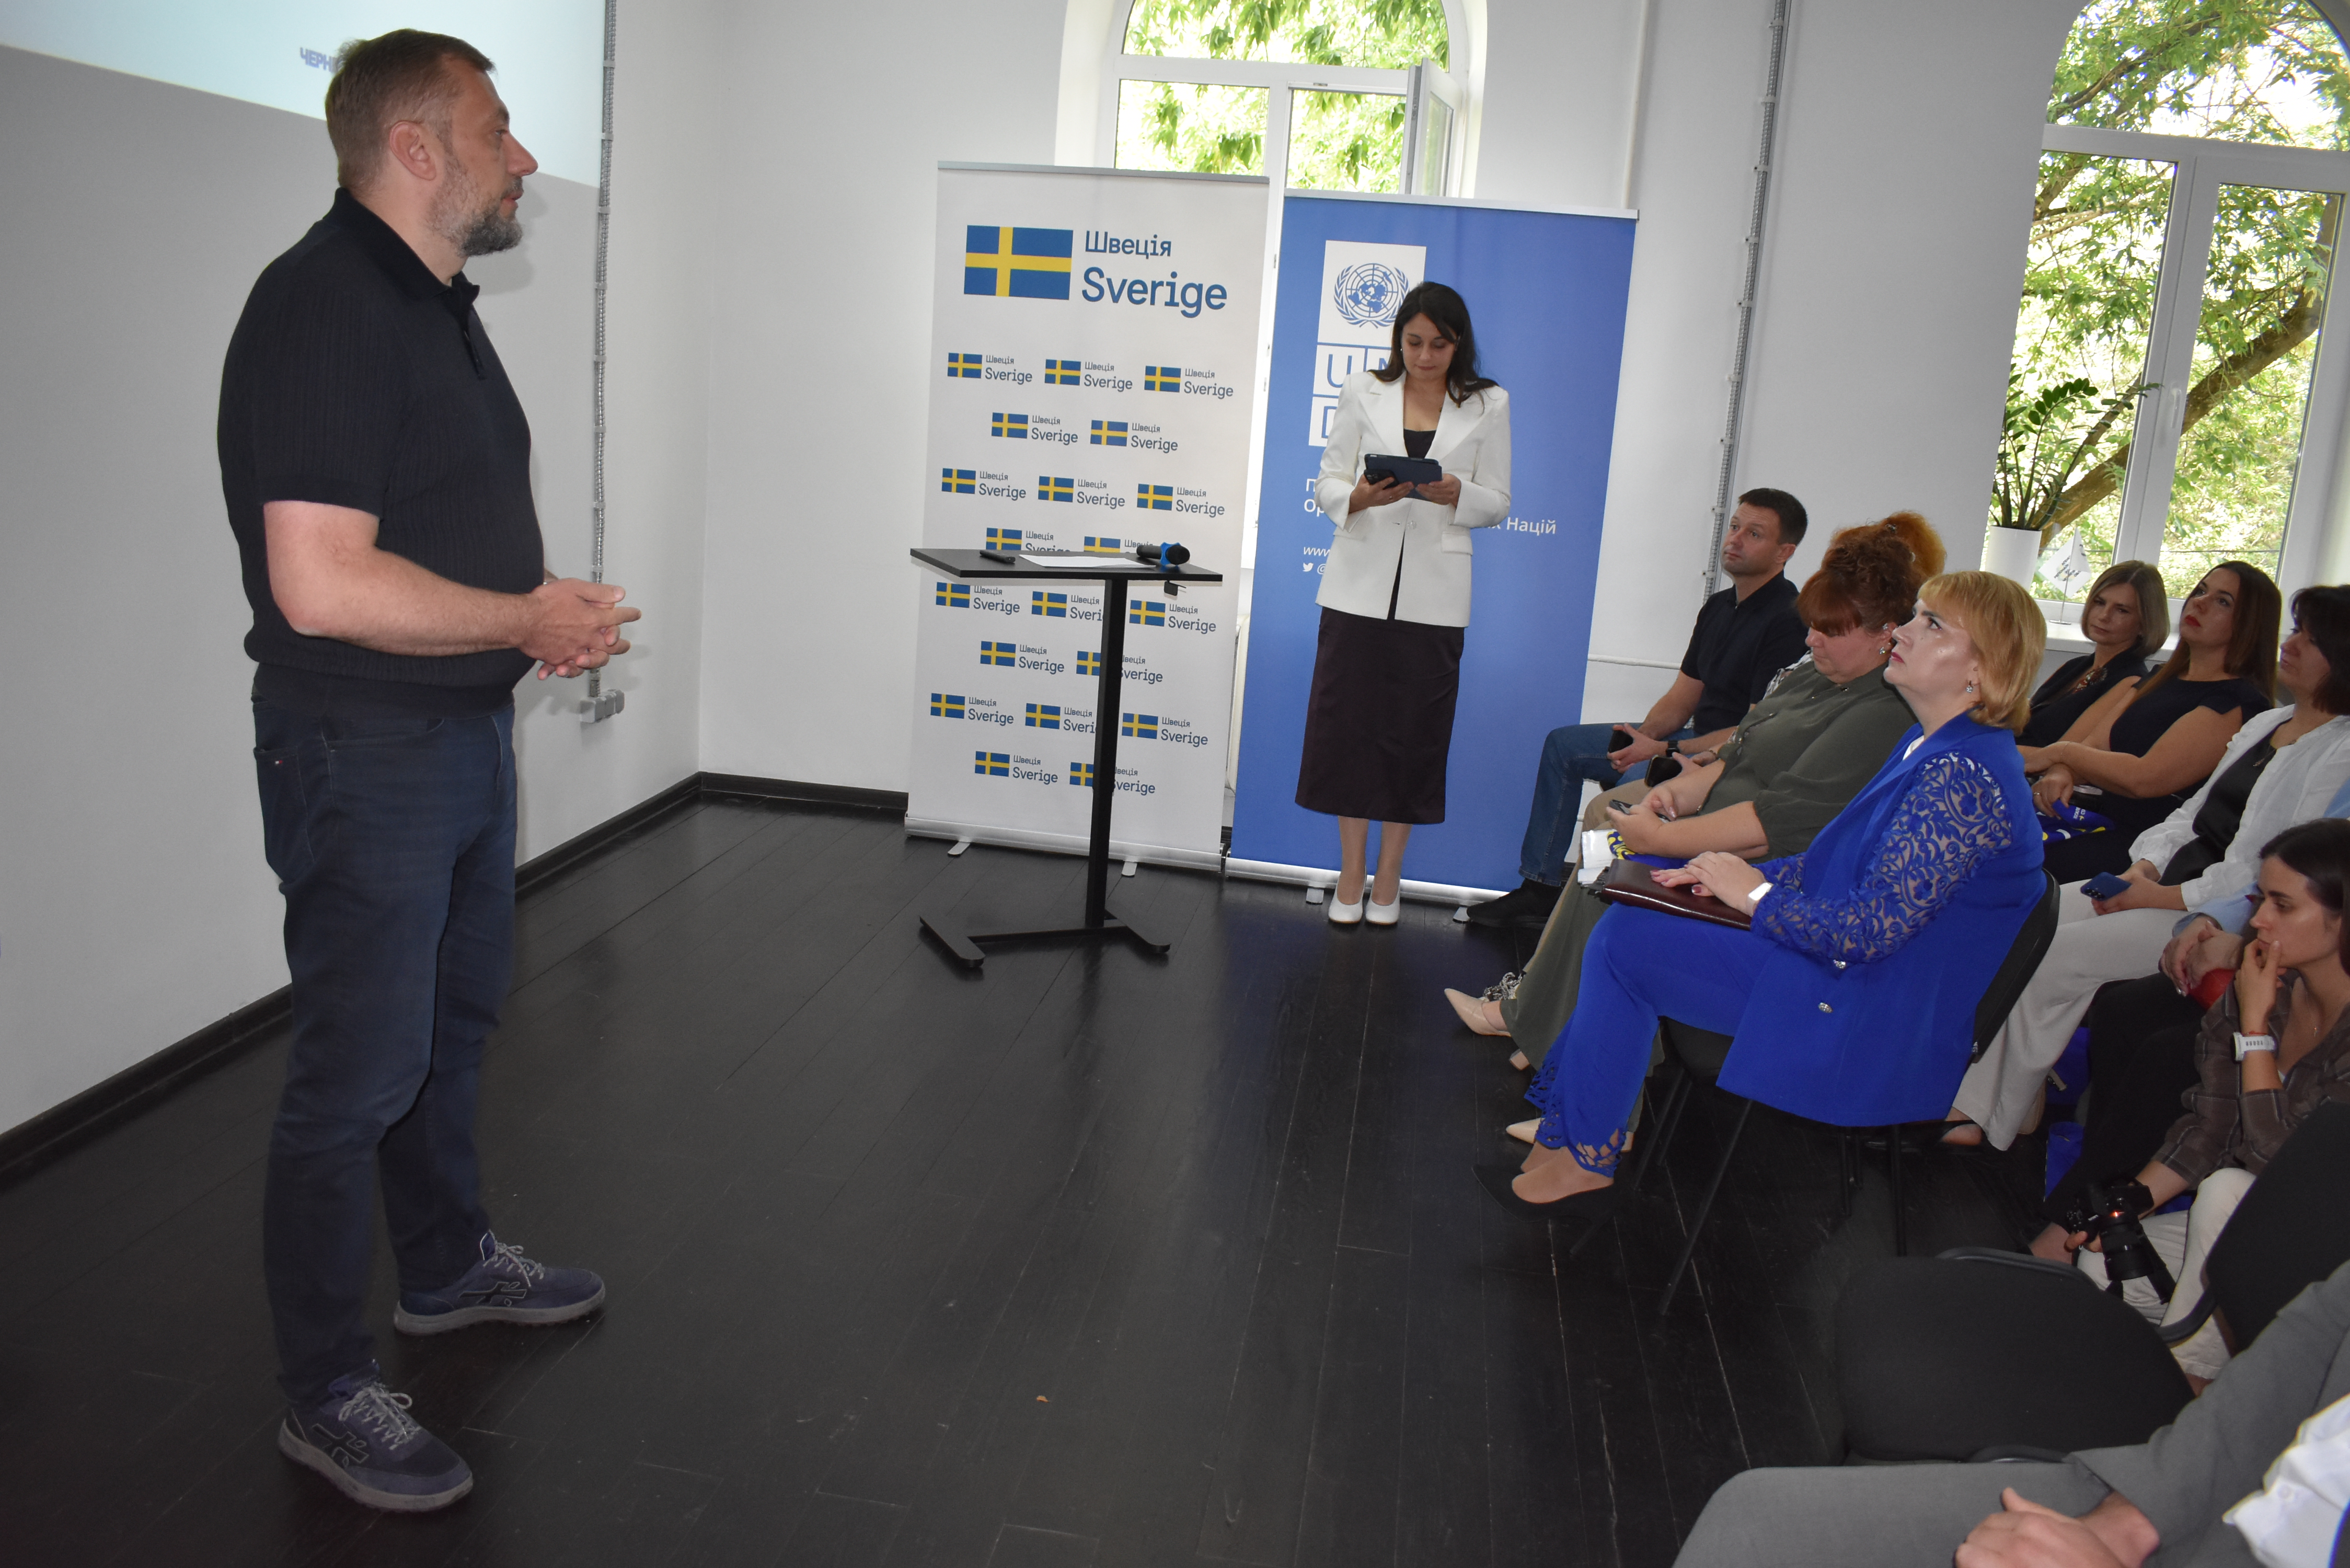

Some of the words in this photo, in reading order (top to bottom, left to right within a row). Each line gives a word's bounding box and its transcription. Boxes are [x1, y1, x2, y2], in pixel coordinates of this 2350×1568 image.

[1085, 230, 1171, 259] Швеція
[1082, 267, 1227, 318] Sverige
[986, 355, 1014, 365] Швеція
[1085, 362, 1114, 372] Швеція
[985, 367, 1032, 385] Sverige
[1185, 368, 1215, 378] Швеція
[1084, 374, 1133, 392] Sverige
[1184, 381, 1233, 399] Sverige
[1032, 416, 1060, 425] Швеція
[1132, 423, 1160, 433] Швеція
[1031, 428, 1078, 445] Sverige
[1131, 435, 1178, 453] Sverige
[980, 471, 1008, 481] Швеція
[1078, 479, 1107, 489] Швеція
[979, 483, 1026, 501] Sverige
[1177, 487, 1206, 498] Швеція
[1077, 491, 1125, 509] Sverige
[1176, 500, 1225, 517] Sverige
[1506, 517, 1557, 536] Націй
[1026, 531, 1053, 541] Швеція
[974, 585, 1003, 595] Швеція
[973, 597, 1020, 615] Sverige
[1071, 595, 1099, 605] Швеція
[1070, 607, 1103, 621] Sveri
[1169, 604, 1197, 614] Швеція
[1168, 616, 1216, 634] Sverige
[1020, 644, 1046, 655] Швеція
[1019, 656, 1064, 675] Sverige
[1122, 654, 1146, 665] веція
[1121, 666, 1163, 685] verige
[969, 697, 996, 707] Швеція
[969, 708, 1013, 726] Sverige
[1064, 707, 1092, 718] Швеція
[1063, 719, 1096, 734] Sveri
[1162, 717, 1190, 728] Швеція
[1161, 729, 1208, 747] Sverige
[1013, 755, 1041, 765] Швеція
[1013, 767, 1058, 785] Sverige
[1115, 767, 1138, 777] веція
[1114, 779, 1156, 795] verige
